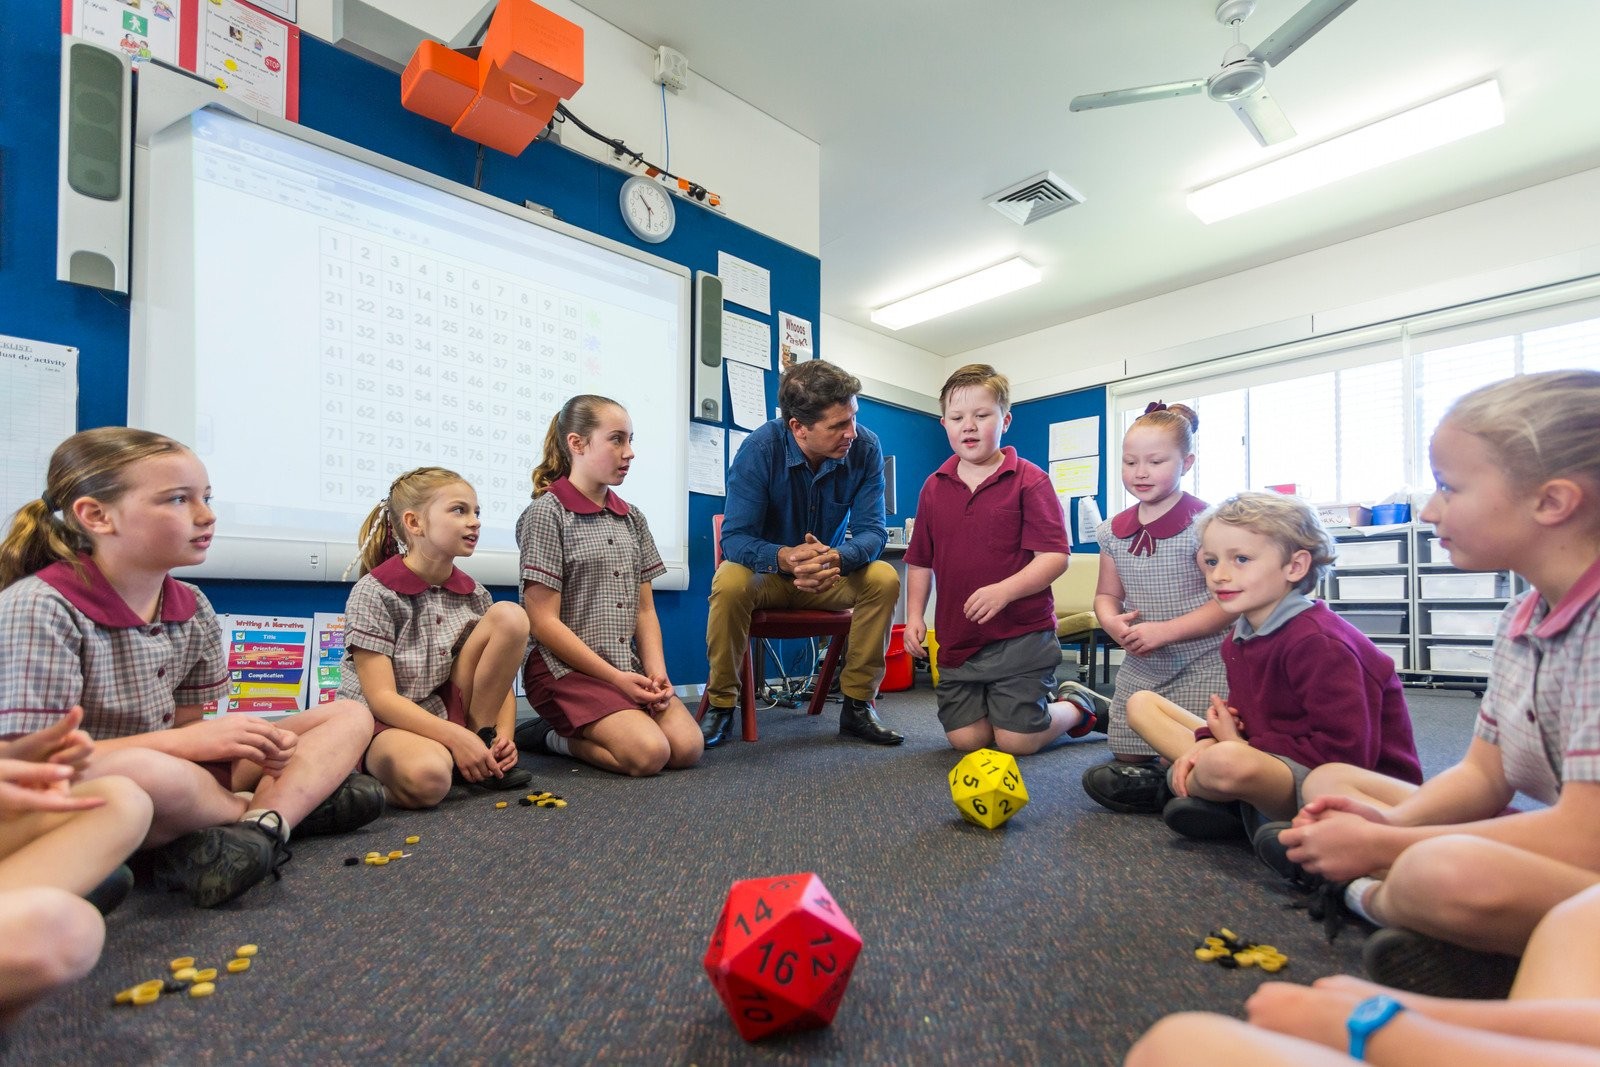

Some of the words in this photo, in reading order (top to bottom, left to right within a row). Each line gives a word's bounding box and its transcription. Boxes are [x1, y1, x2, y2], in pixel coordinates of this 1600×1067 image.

[266, 59, 280, 69] STOP
[331, 237, 338, 251] 1
[360, 247, 371, 261] 2
[390, 256, 400, 269] 3
[417, 265, 428, 276] 4
[445, 271, 455, 284] 5
[471, 280, 481, 291] 6
[495, 286, 505, 297] 7
[520, 293, 529, 305] 8
[543, 300, 553, 311] 9
[564, 305, 576, 318] 10
[327, 264, 343, 279] 11
[358, 272, 376, 288] 12
[387, 280, 405, 295] 13
[416, 288, 432, 302] 14
[443, 295, 459, 310] 15
[469, 302, 485, 316] 16
[493, 309, 509, 322] 17
[517, 316, 532, 329] 18
[541, 322, 556, 335] 19
[562, 328, 577, 341] 20
[325, 291, 343, 306] 21
[356, 299, 376, 314] 22
[385, 306, 405, 321] 23
[414, 313, 432, 328] 24
[441, 320, 459, 334] 25
[467, 327, 485, 340] 26
[492, 333, 508, 346] 27
[516, 339, 532, 352] 28
[540, 345, 555, 358] 29
[561, 351, 577, 364] 30
[786, 332, 808, 347] Task?
[0, 342, 33, 352] KLIST:
[34, 357, 67, 367] activity
[324, 318, 344, 333] 31
[356, 325, 376, 341] 32
[385, 332, 405, 346] 33
[414, 338, 432, 353] 34
[441, 345, 459, 359] 35
[467, 351, 485, 365] 36
[492, 357, 509, 370] 37
[516, 362, 532, 376] 38
[539, 368, 555, 380] 39
[561, 374, 577, 386] 40
[324, 346, 344, 360] 41
[355, 352, 376, 367] 42
[385, 359, 405, 372] 43
[414, 365, 433, 378] 44
[440, 370, 459, 383] 45
[467, 376, 484, 389] 46
[492, 381, 508, 393] 47
[516, 387, 532, 399] 48
[538, 392, 555, 403] 49
[325, 372, 344, 387] 51
[356, 378, 377, 393] 52
[385, 384, 405, 398] 53
[413, 389, 433, 403] 54
[441, 395, 459, 408] 55
[467, 400, 484, 413] 56
[492, 405, 508, 417] 57
[516, 410, 532, 423] 58
[324, 400, 344, 414] 61
[356, 405, 376, 420] 62
[385, 411, 404, 424] 63
[413, 416, 432, 429] 64
[441, 420, 459, 433] 65
[467, 425, 484, 438] 66
[491, 429, 508, 441] 67
[515, 434, 532, 446] 68
[326, 427, 344, 441] 71
[356, 432, 376, 446] 72
[386, 436, 404, 450] 73
[415, 440, 433, 454] 74
[441, 445, 459, 458] 75
[467, 449, 484, 462] 76
[492, 453, 508, 465] 77
[324, 454, 344, 468] 81
[356, 458, 376, 472] 82
[491, 477, 508, 489] 87
[325, 481, 344, 496] 91
[355, 485, 376, 499] 92
[491, 500, 508, 513] 97
[235, 621, 262, 629] Writing
[963, 775, 980, 788] 5
[980, 758, 1000, 775] 11
[1003, 770, 1019, 791] 13
[972, 798, 988, 816] 6
[999, 800, 1013, 815] 2
[735, 898, 773, 936] 14
[758, 941, 799, 985] 16
[810, 931, 837, 977] 12
